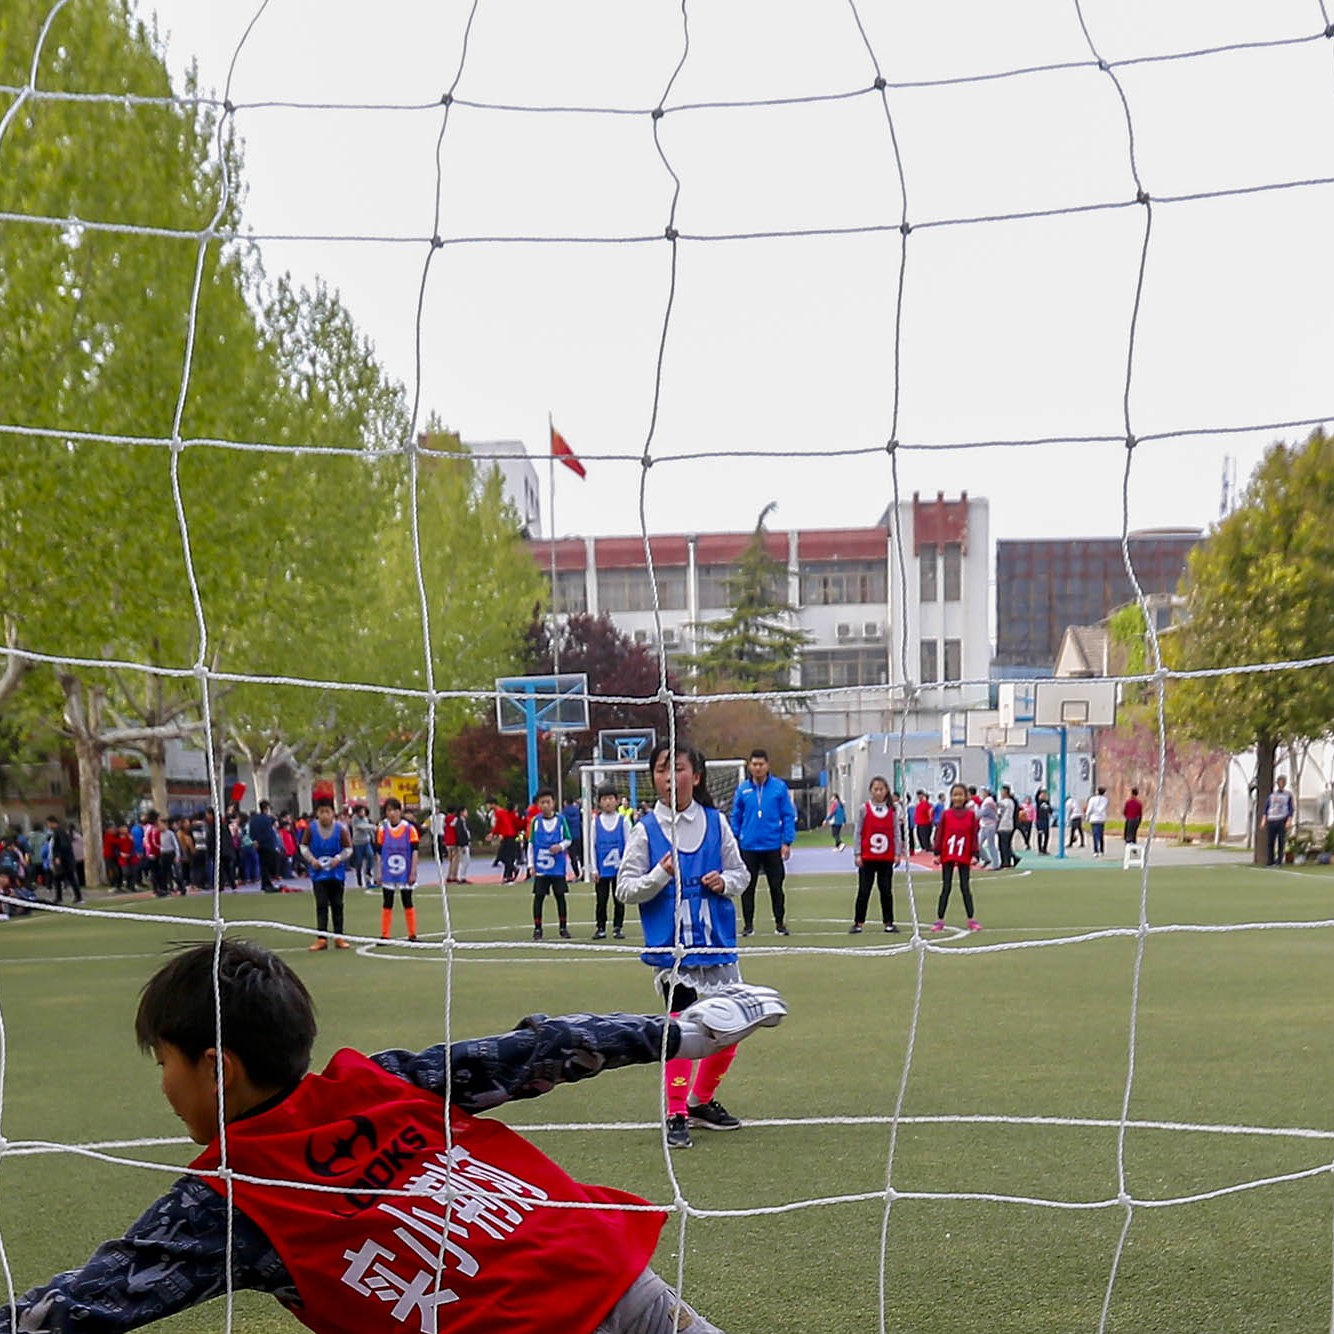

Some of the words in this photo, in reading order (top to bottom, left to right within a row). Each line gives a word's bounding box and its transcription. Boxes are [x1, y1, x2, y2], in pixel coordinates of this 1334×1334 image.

[869, 833, 889, 854] 9
[947, 834, 966, 856] 11
[387, 854, 406, 874] 9
[536, 848, 556, 870] 5
[602, 847, 621, 868] 4
[679, 898, 713, 946] 11
